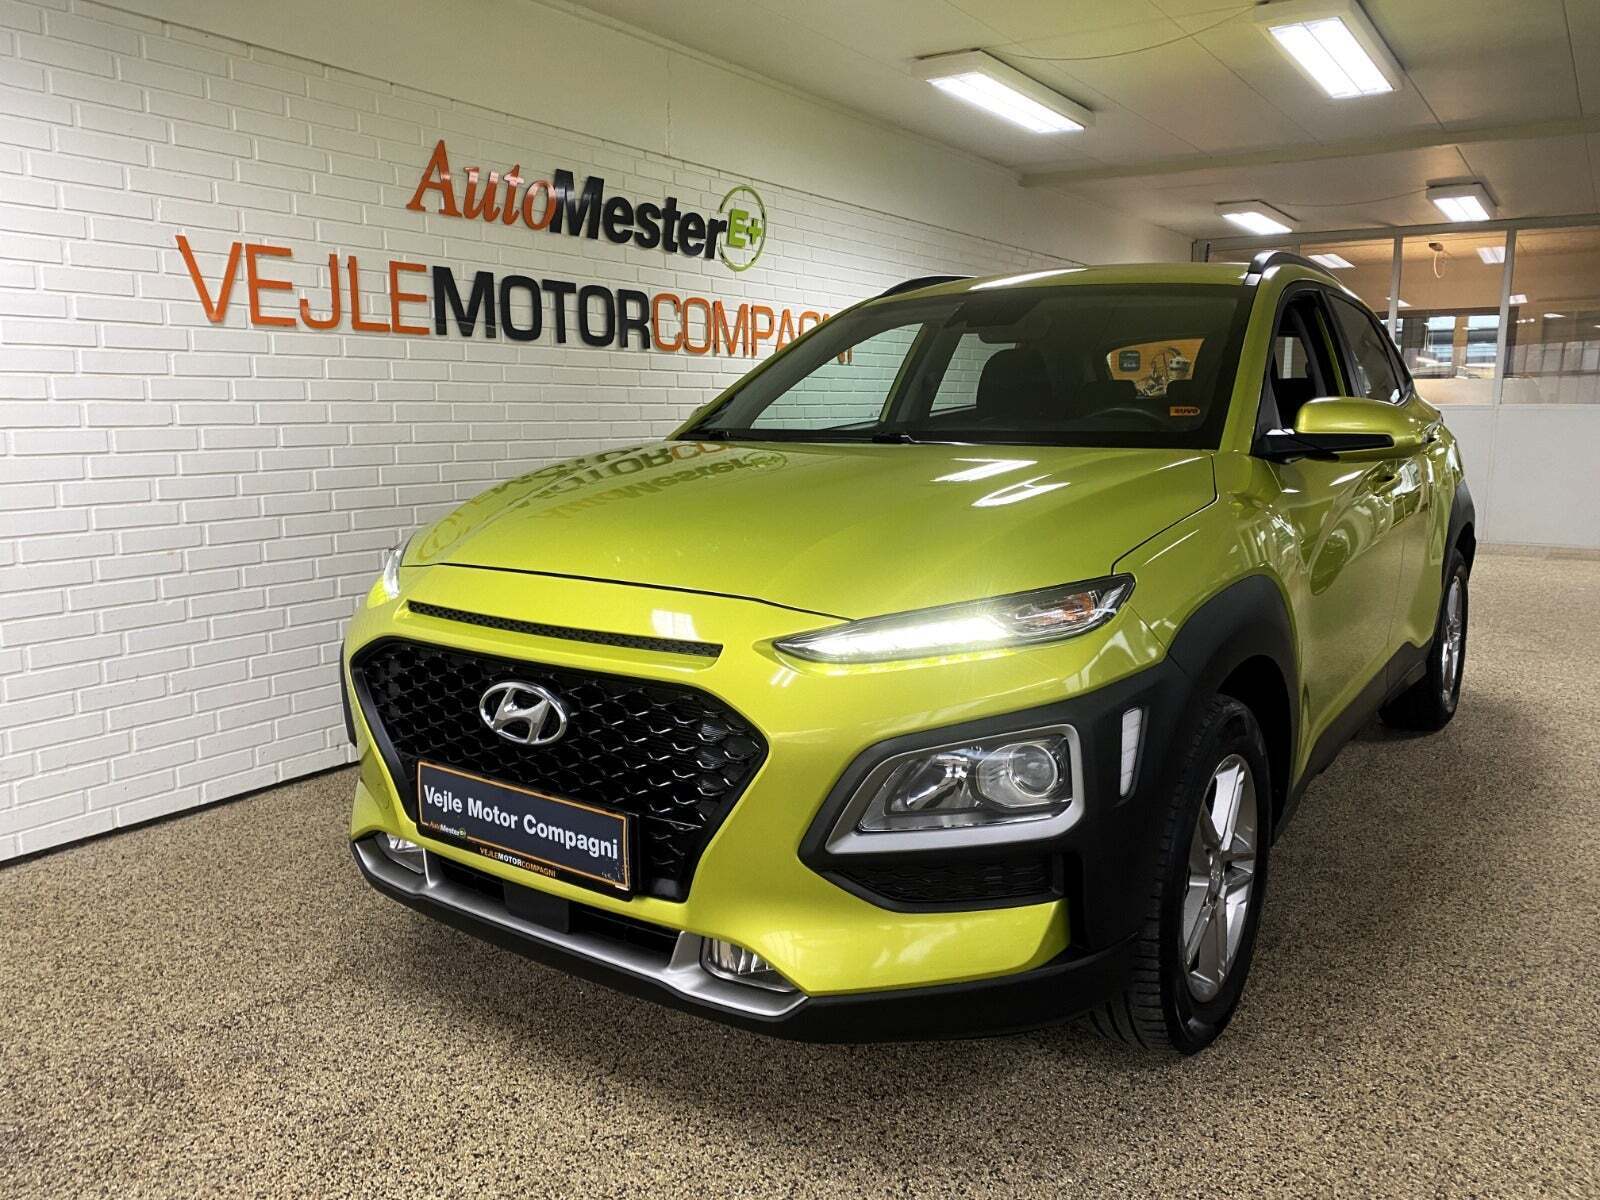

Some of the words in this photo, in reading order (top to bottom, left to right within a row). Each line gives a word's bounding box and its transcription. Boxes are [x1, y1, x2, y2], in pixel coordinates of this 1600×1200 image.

[406, 139, 728, 260] AutoMester
[174, 234, 853, 366] VEJLEMOTORCOMPA
[423, 784, 463, 813] Vejle
[467, 797, 518, 830] Motor
[523, 813, 618, 860] Compagni
